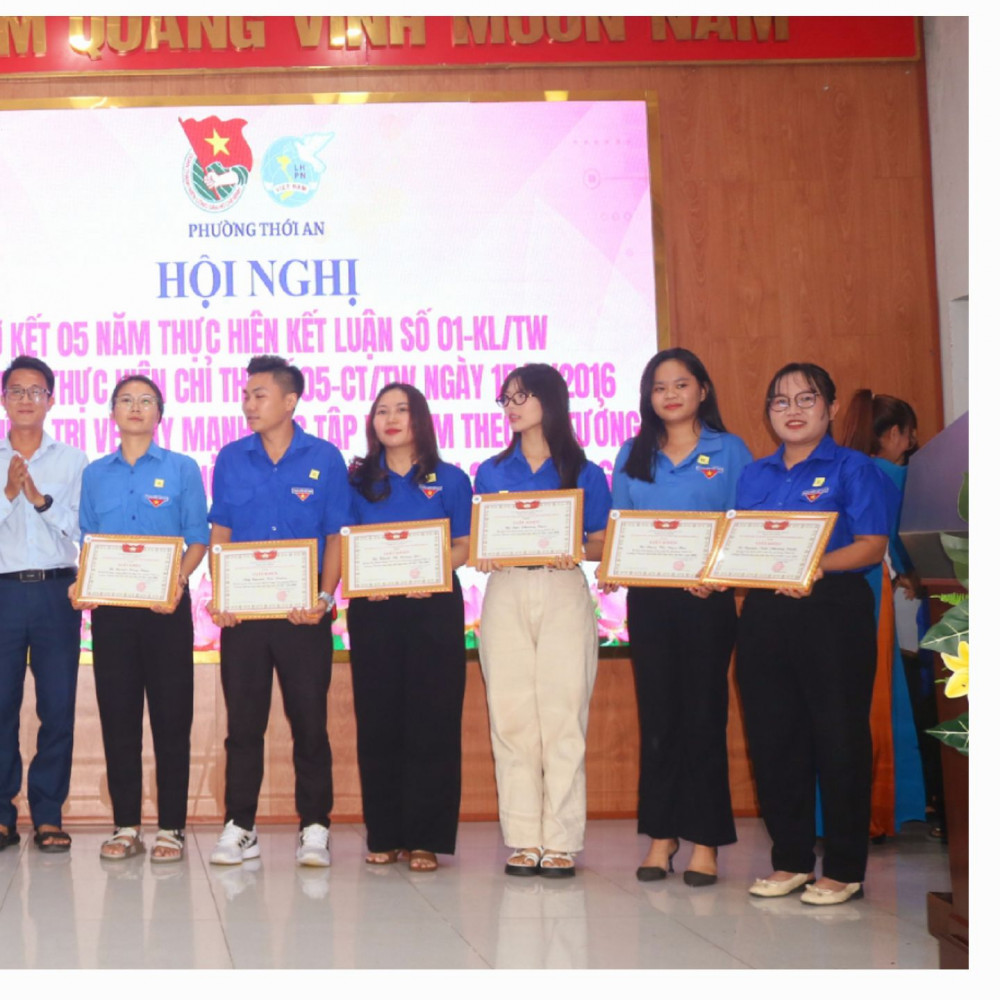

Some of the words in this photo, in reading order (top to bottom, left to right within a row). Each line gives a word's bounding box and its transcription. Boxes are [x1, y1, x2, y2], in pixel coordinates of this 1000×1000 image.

[67, 16, 267, 60] QUANG
[188, 220, 257, 238] PHƯỜNG
[259, 219, 299, 237] THỚI
[302, 221, 325, 236] AN
[155, 254, 238, 309] HỘI
[247, 258, 360, 307] NGHỊ
[10, 313, 50, 358] KẾT
[57, 321, 89, 356] 05
[96, 312, 150, 356] NĂM
[158, 316, 221, 364] THỰC
[286, 309, 326, 354] KẾT
[334, 308, 393, 360] LUẬN
[400, 308, 432, 353] SỐ
[437, 315, 548, 351] 01-KL/TW
[174, 355, 212, 403] CHỈ
[219, 367, 248, 403] TH
[424, 355, 484, 401] NGÀY
